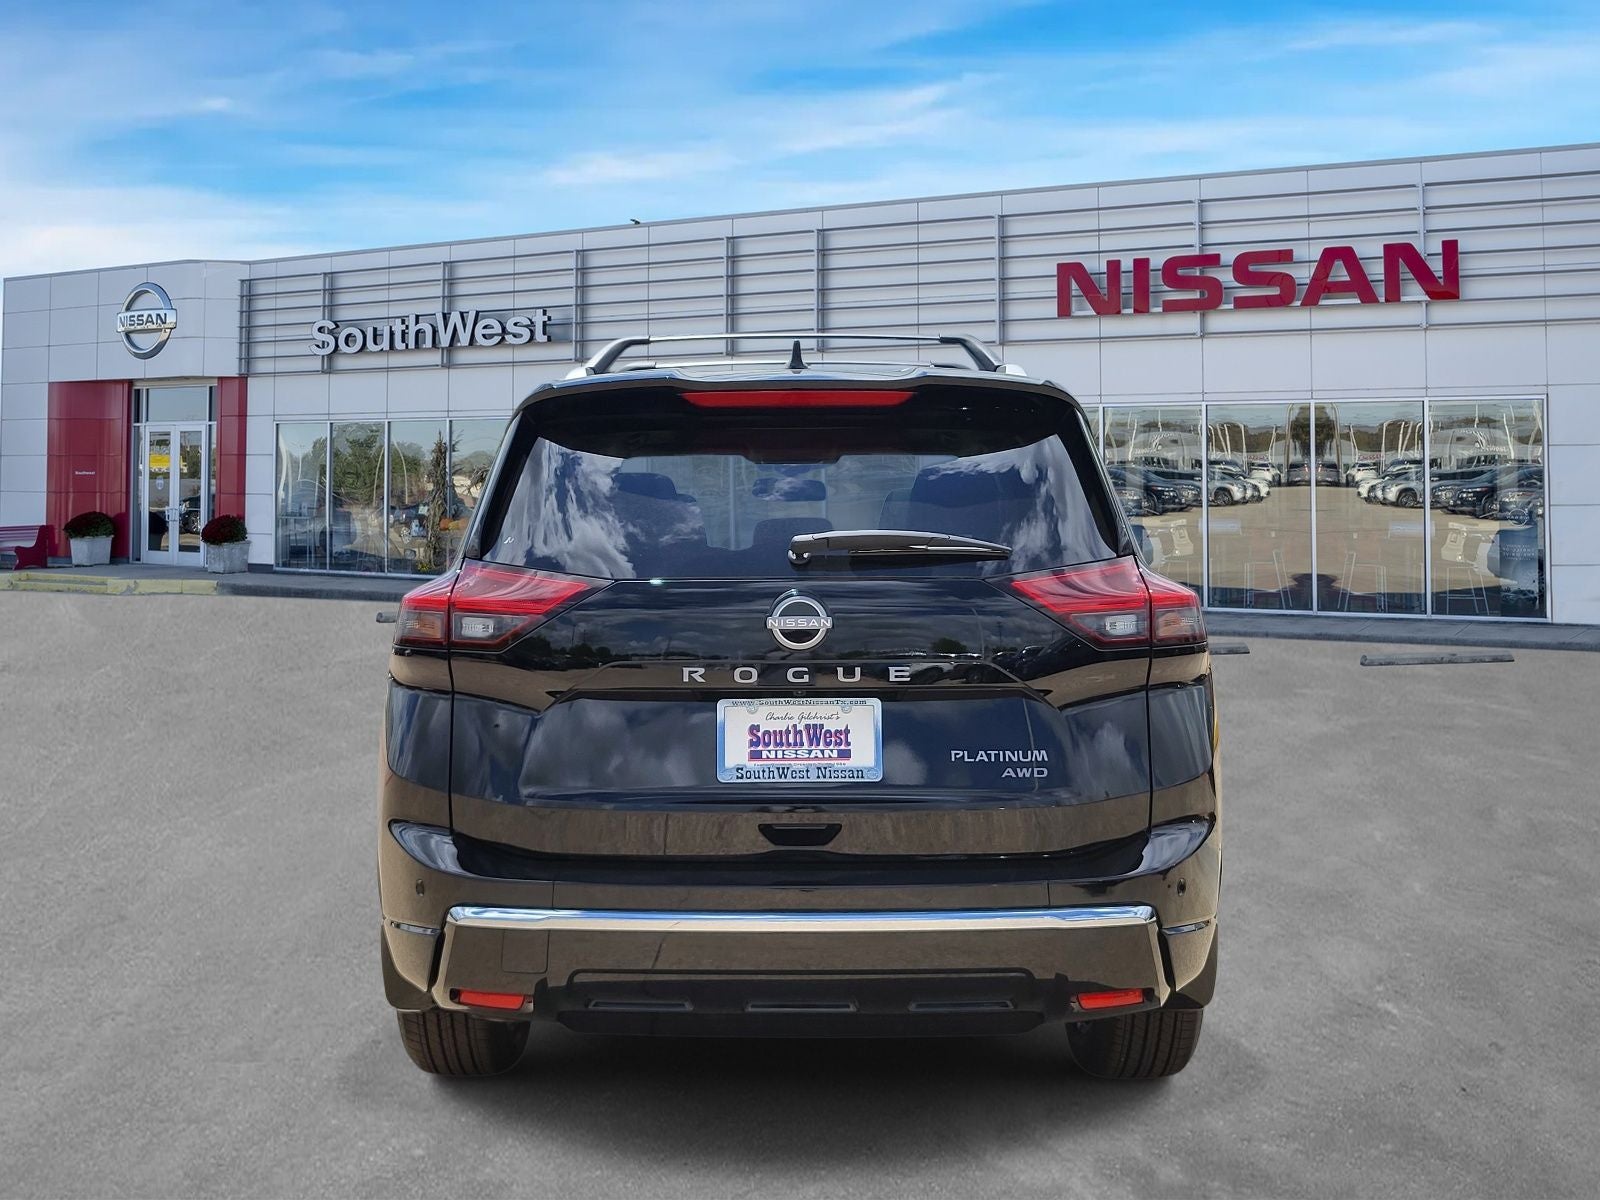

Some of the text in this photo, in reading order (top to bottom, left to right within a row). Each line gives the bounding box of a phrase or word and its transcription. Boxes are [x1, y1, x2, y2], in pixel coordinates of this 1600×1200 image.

[1057, 239, 1460, 318] NISSAN
[119, 313, 167, 327] NISSAN
[310, 309, 550, 356] SouthWest
[768, 618, 832, 627] NISSAN
[682, 667, 911, 683] ROGUE
[765, 711, 794, 721] Charlie
[748, 723, 851, 748] SouthWest
[761, 749, 839, 759] NISSAN
[950, 750, 1048, 762] PLATINUM
[736, 766, 865, 780] SouthWest Nissan
[1001, 767, 1048, 778] AWD
